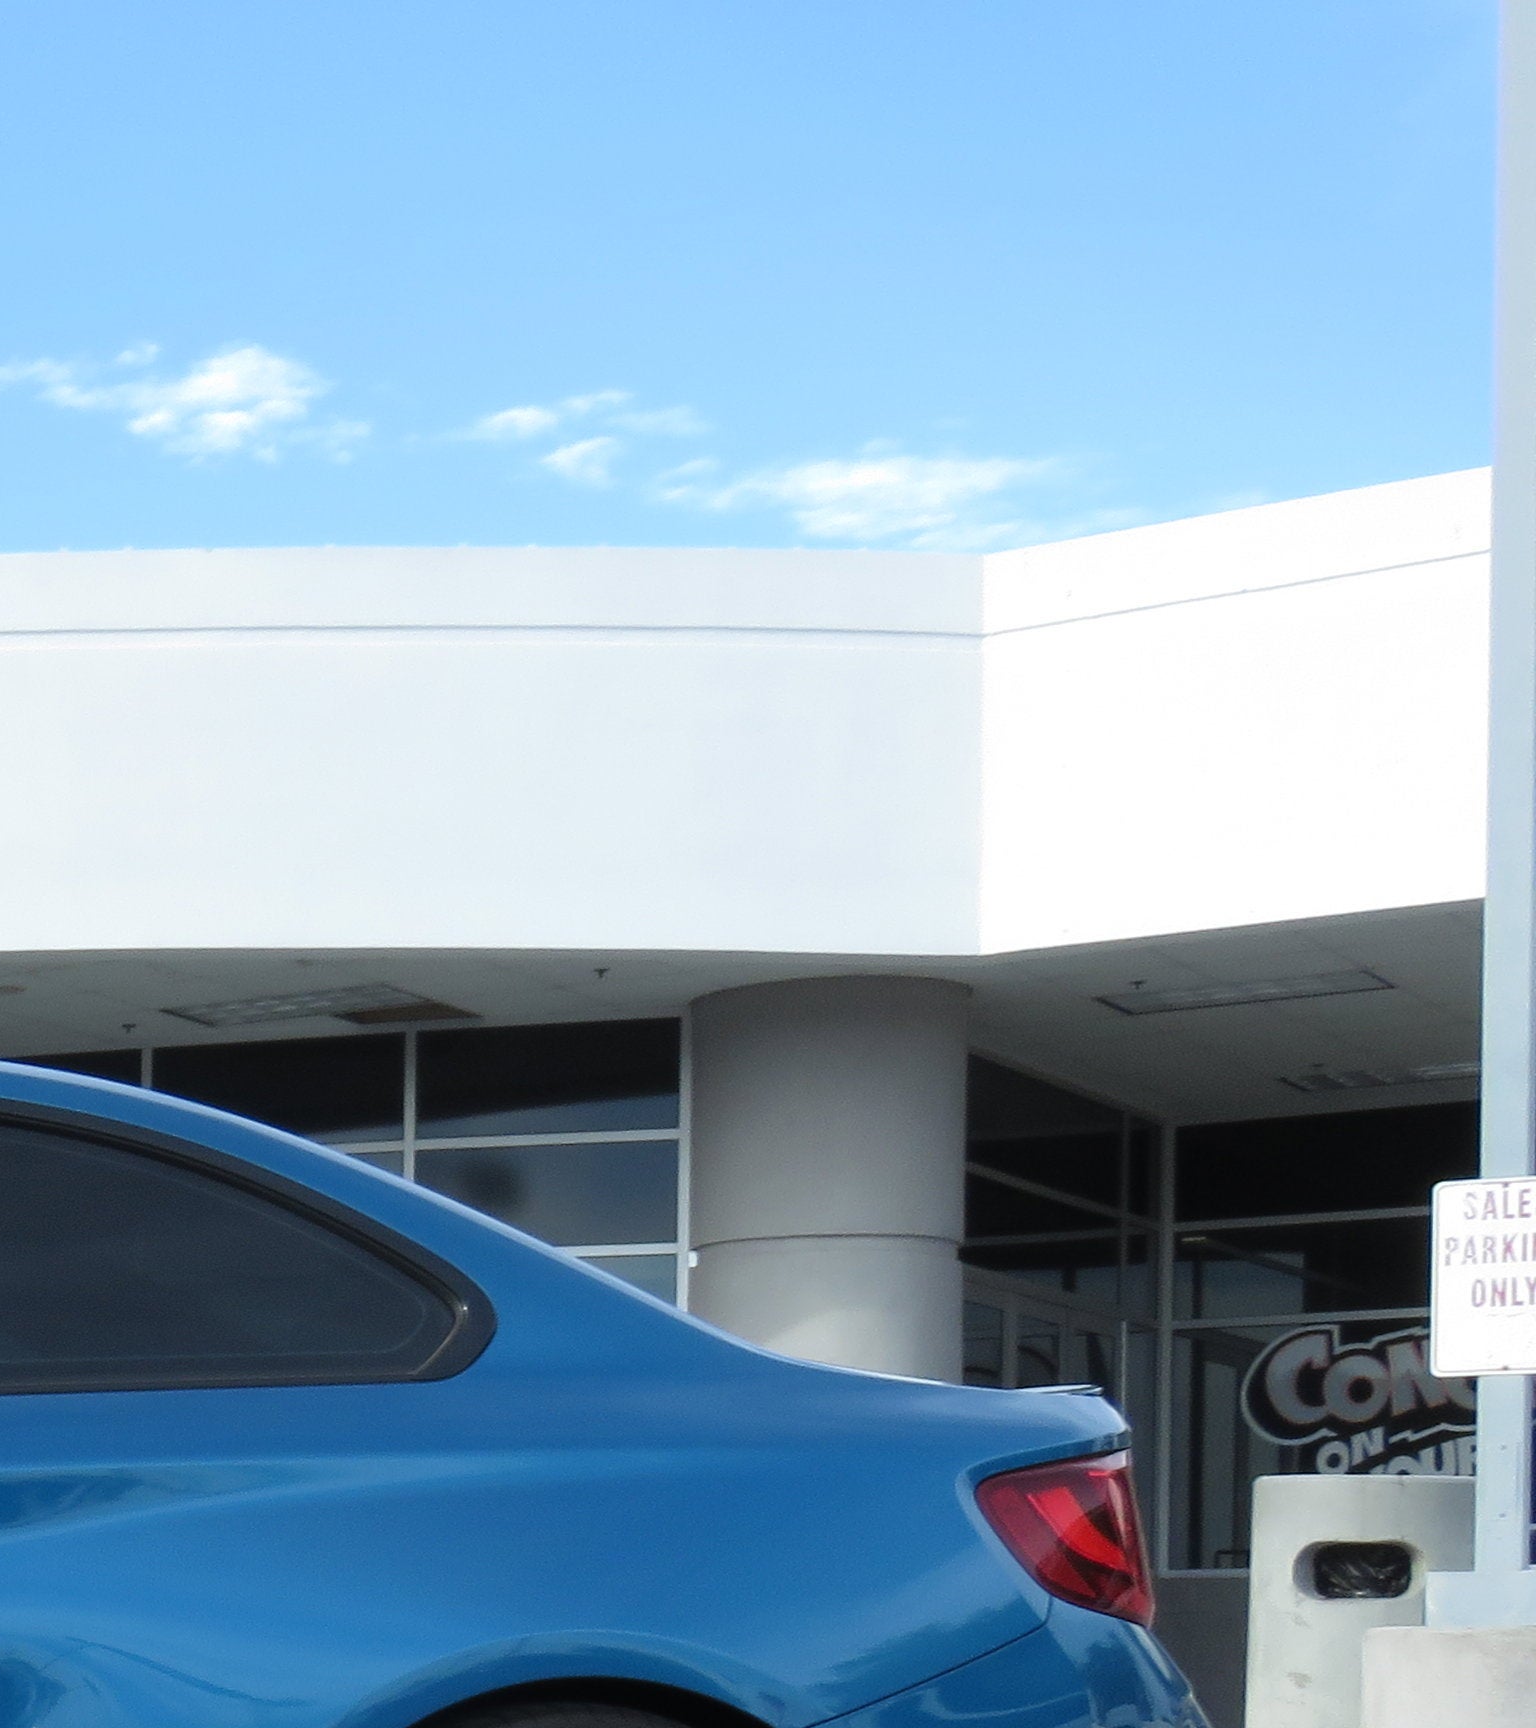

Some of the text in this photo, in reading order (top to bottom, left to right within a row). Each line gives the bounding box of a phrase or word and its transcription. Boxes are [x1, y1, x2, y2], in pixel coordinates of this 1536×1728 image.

[1463, 1188, 1536, 1221] SALE
[1471, 1276, 1536, 1308] ONLY
[1316, 1426, 1385, 1475] ON
